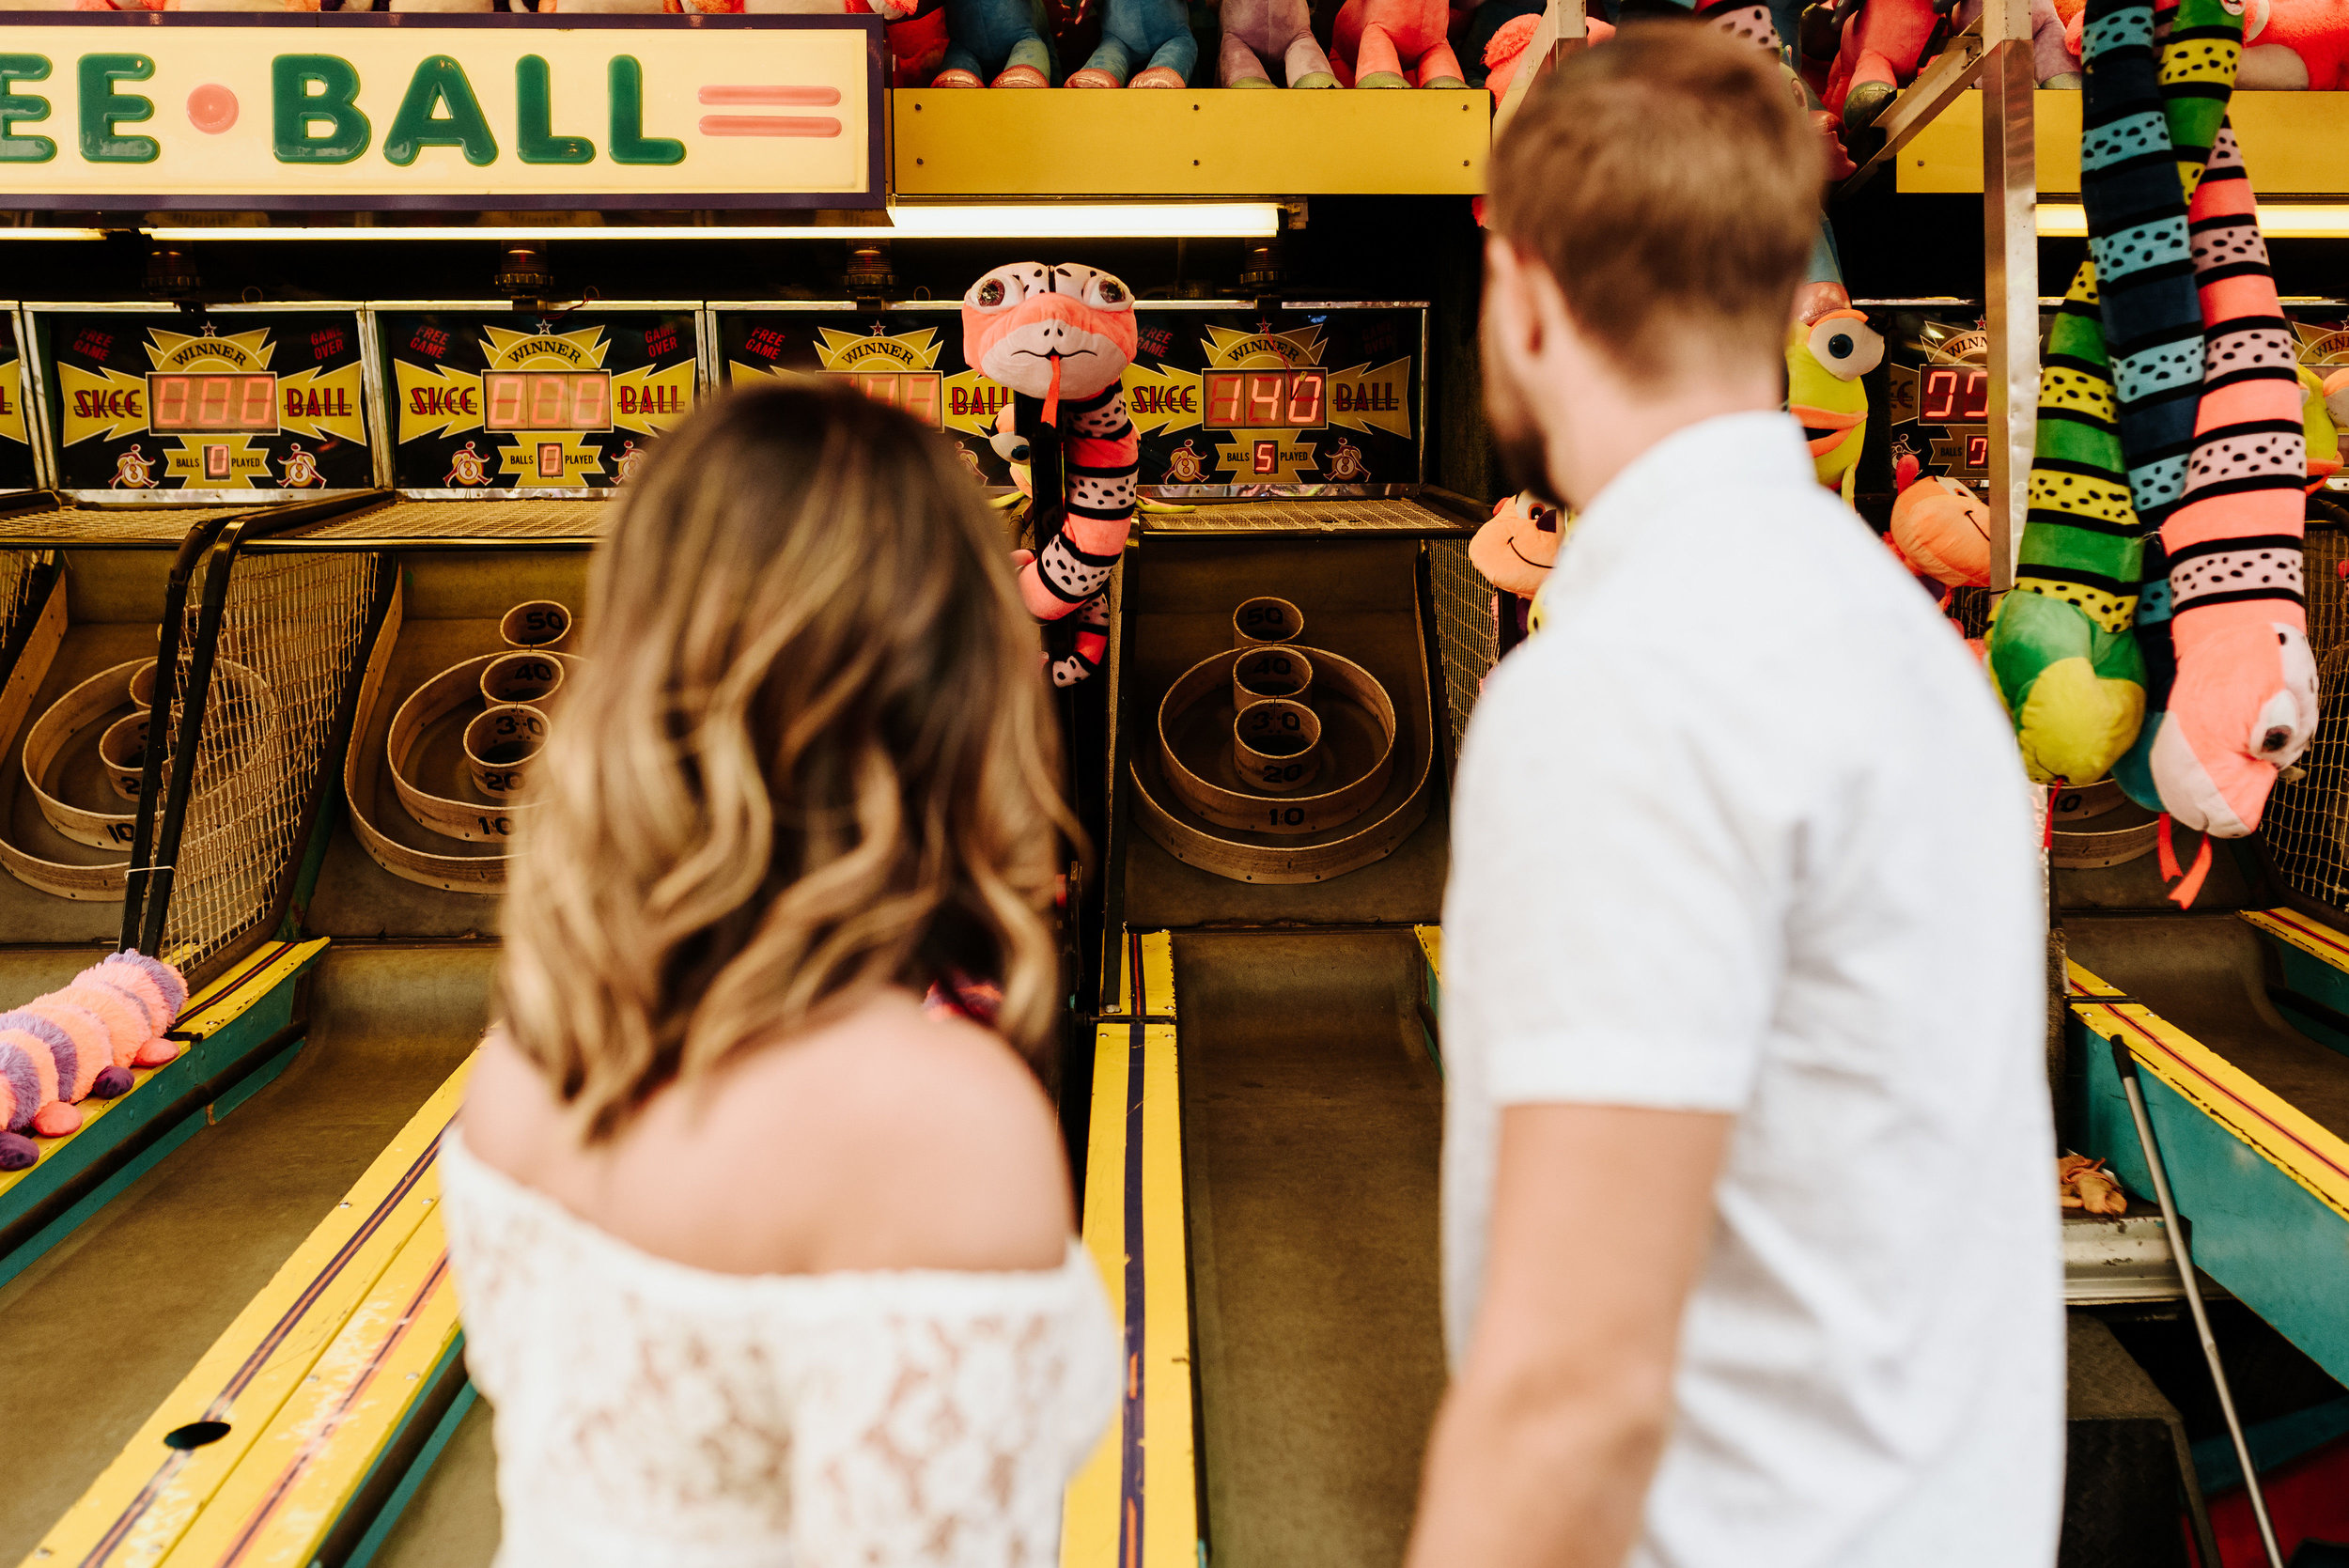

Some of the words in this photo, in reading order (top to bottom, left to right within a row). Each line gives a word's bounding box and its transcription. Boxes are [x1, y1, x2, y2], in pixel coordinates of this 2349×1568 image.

[272, 54, 686, 167] BALL
[79, 327, 115, 349] FREE
[310, 326, 344, 346] GAME
[416, 326, 451, 347] FREE
[645, 325, 677, 344] GAME
[751, 326, 786, 348] FREE
[1140, 324, 1174, 345] FREE
[73, 339, 111, 362] GAME
[172, 342, 247, 366] WINNER
[314, 339, 344, 360] OVER
[410, 336, 446, 360] GAME
[507, 341, 583, 365] WINNER
[648, 336, 677, 358] OVER
[744, 338, 782, 361] GAME
[841, 342, 915, 366] WINNER
[1227, 339, 1299, 363] WINNER
[2312, 336, 2349, 358] WIN
[74, 388, 142, 418] SKEE
[156, 377, 274, 425] 000
[286, 387, 351, 417] BALL
[411, 386, 477, 416] SKEE
[490, 378, 606, 425] 000
[620, 385, 685, 414] BALL
[1130, 384, 1197, 414] SKEE
[1335, 382, 1399, 411] BALL
[209, 445, 228, 474] 0
[510, 455, 534, 465] BALLS
[565, 454, 594, 464] PLAYED
[541, 445, 561, 474] 0
[1227, 452, 1250, 462] BALLS
[1280, 452, 1309, 462] PLAYED
[1255, 443, 1274, 472] 5
[1940, 446, 1963, 457] BALLS
[176, 458, 200, 468] BALLS
[231, 458, 260, 468] PLAYED
[525, 612, 564, 630] 50
[1247, 607, 1283, 626] 50
[514, 662, 552, 681] 40
[1253, 658, 1291, 675] 40
[495, 715, 545, 737] 30
[1252, 711, 1301, 731] 30
[485, 772, 526, 792] 20
[1263, 764, 1302, 784] 20
[120, 776, 141, 795] 2
[478, 816, 516, 835] 10
[1268, 807, 1305, 826] 10
[106, 823, 134, 844] 10
